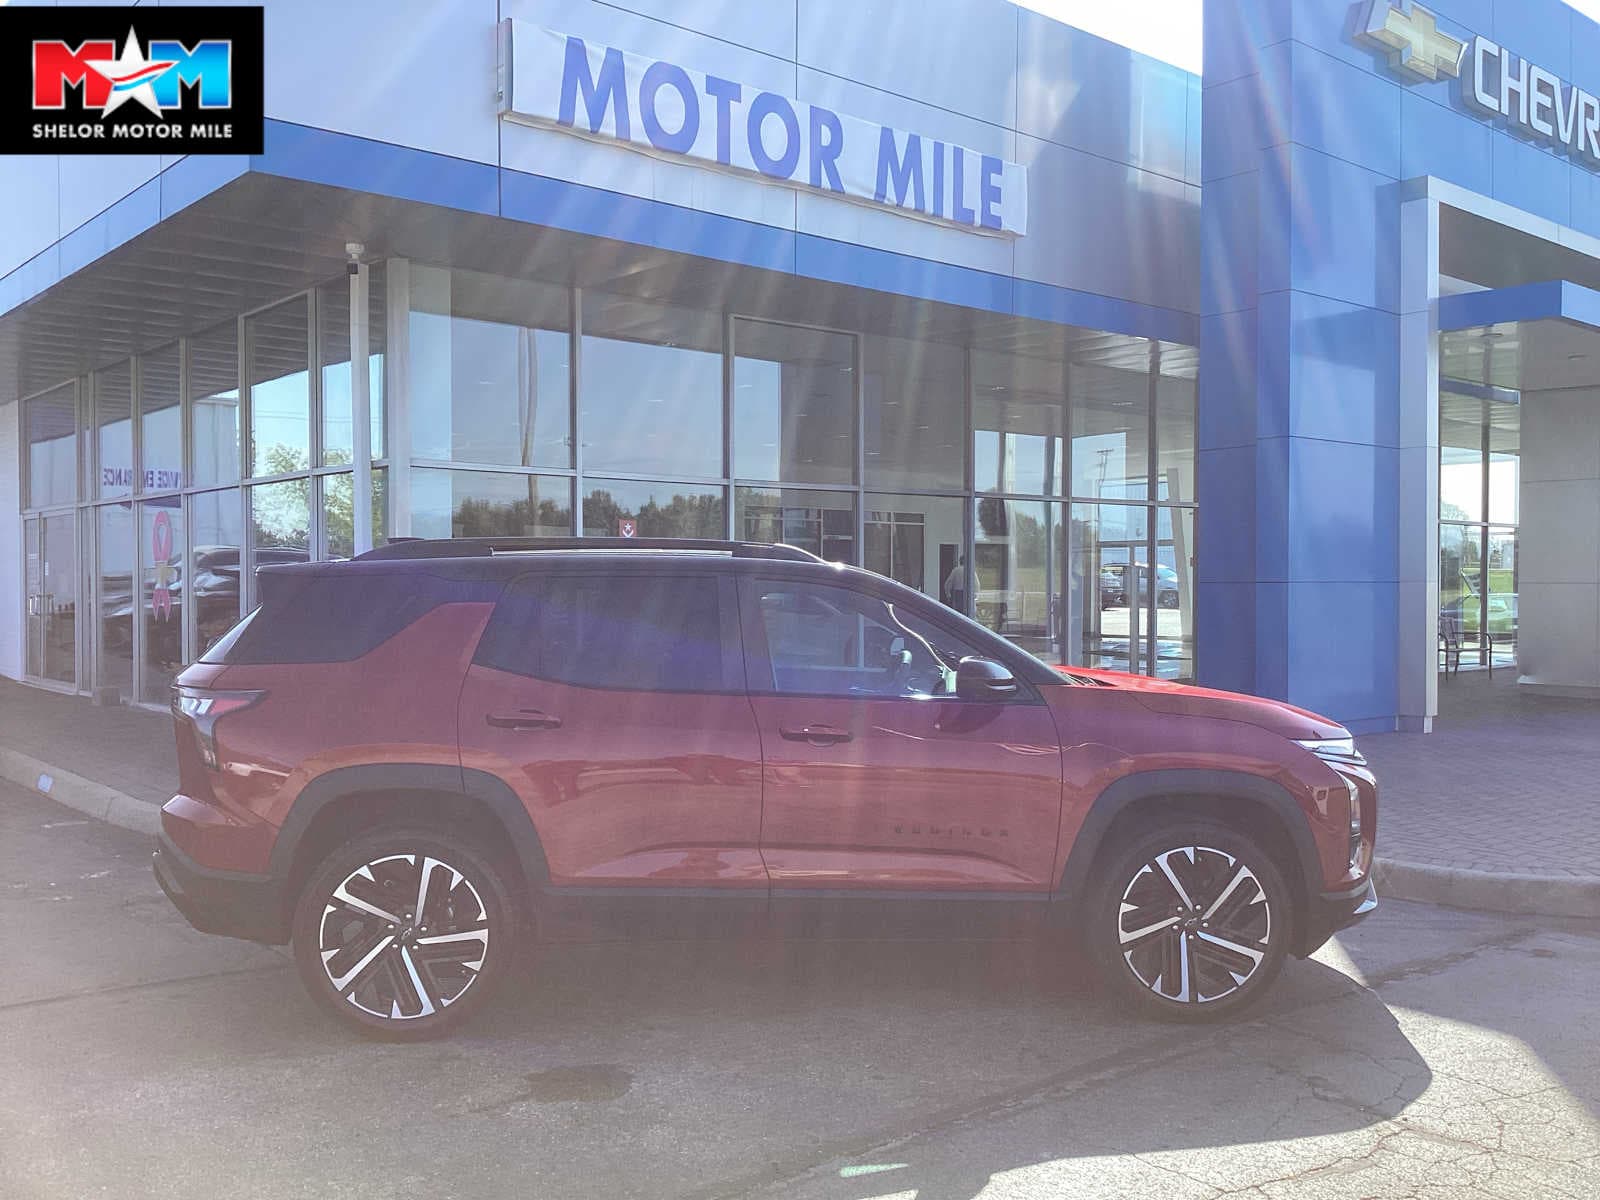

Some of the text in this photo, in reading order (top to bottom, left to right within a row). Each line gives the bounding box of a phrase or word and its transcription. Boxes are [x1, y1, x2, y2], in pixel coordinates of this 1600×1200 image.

[556, 36, 1003, 230] MOTOR MILE
[1474, 35, 1600, 160] CHEVR
